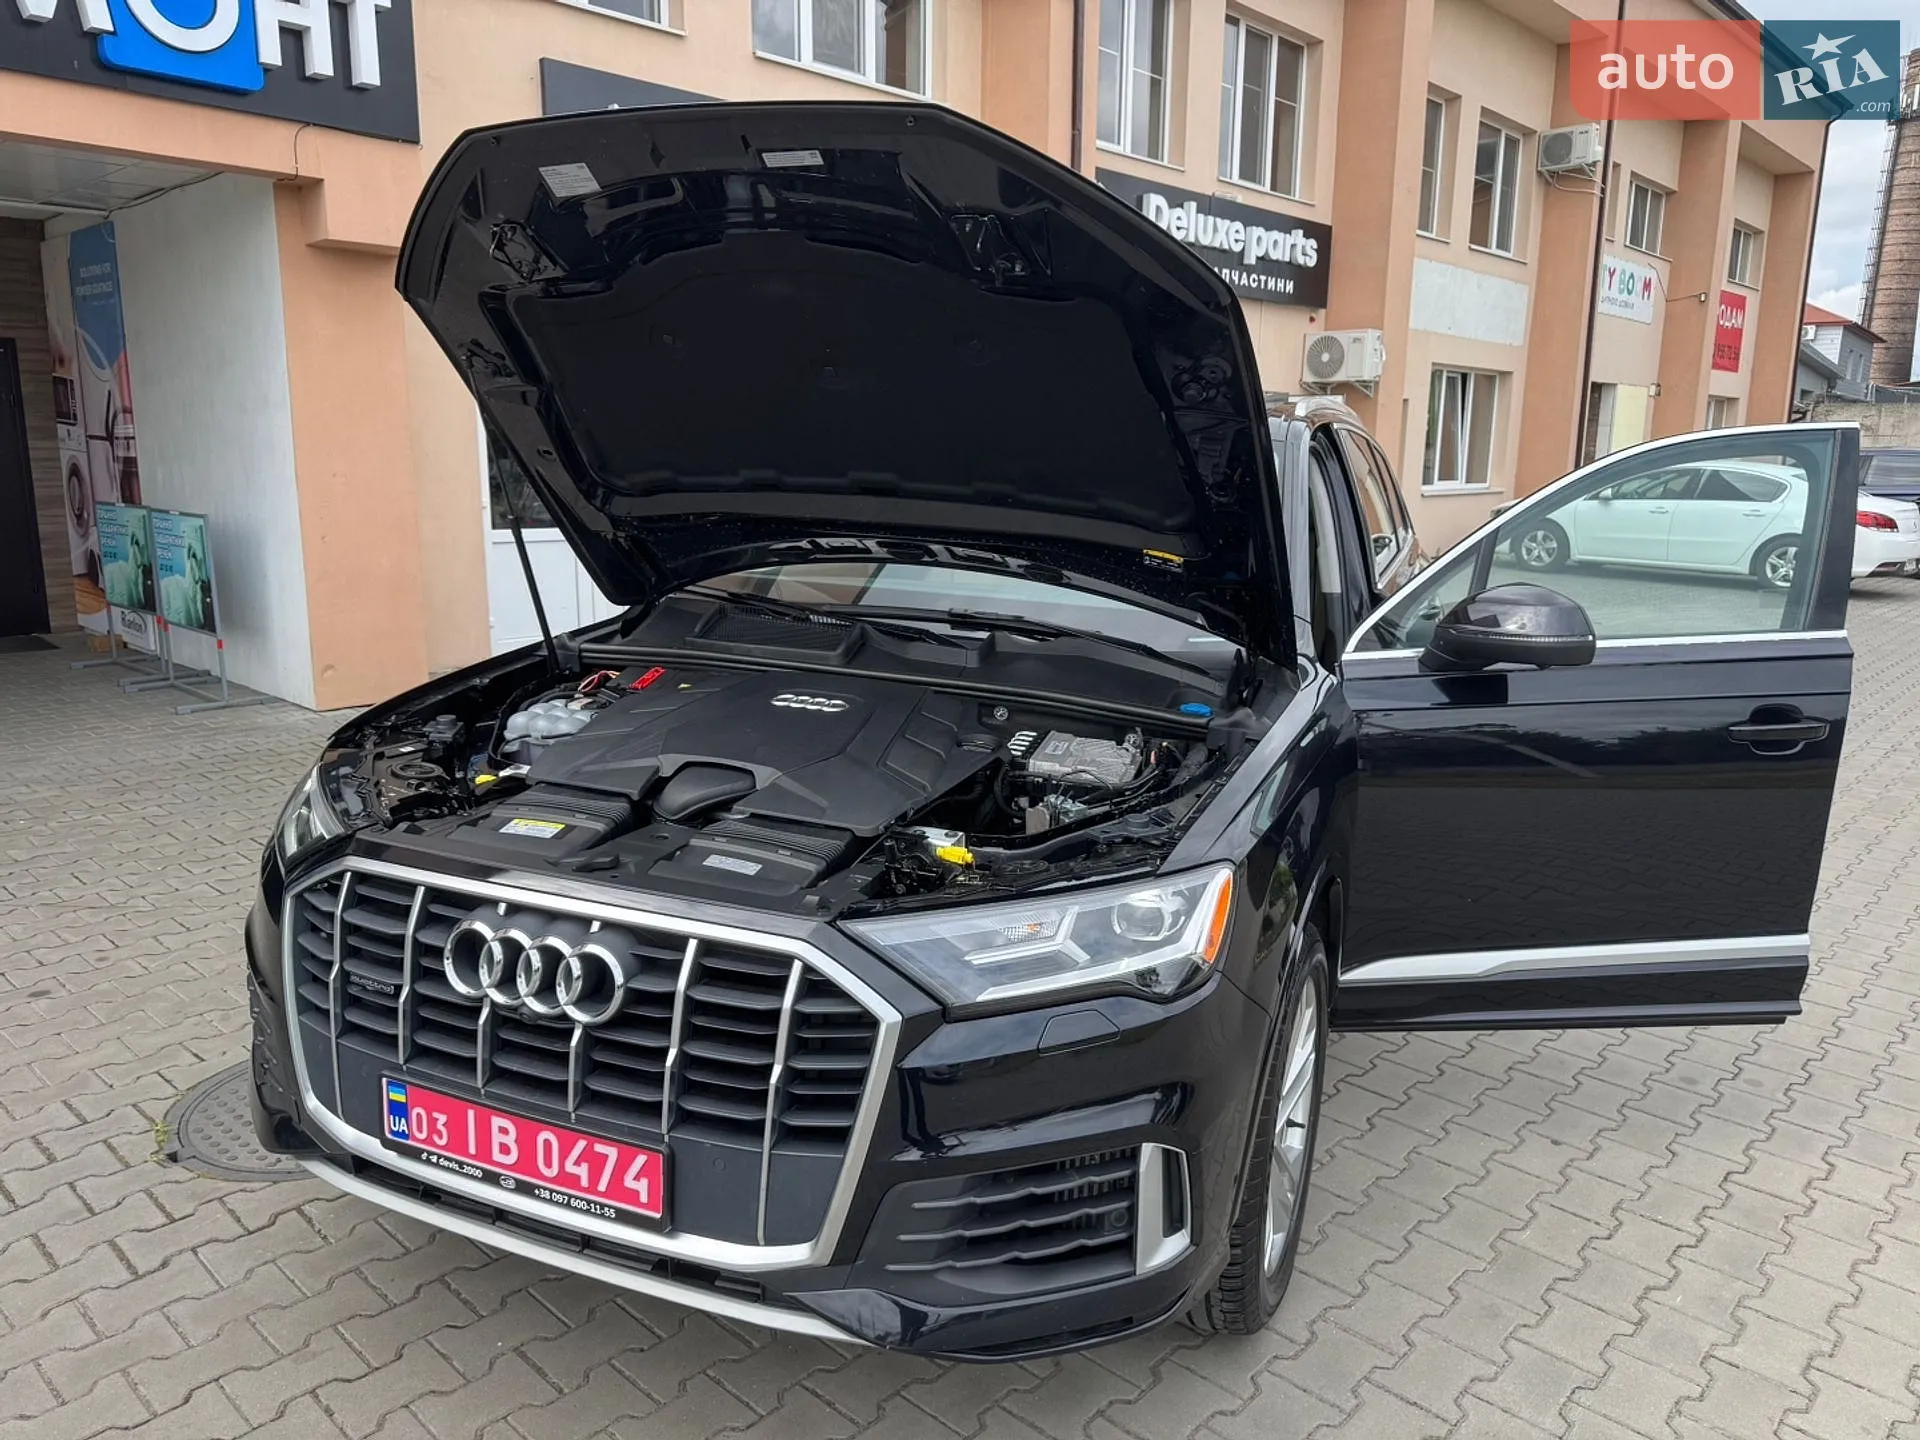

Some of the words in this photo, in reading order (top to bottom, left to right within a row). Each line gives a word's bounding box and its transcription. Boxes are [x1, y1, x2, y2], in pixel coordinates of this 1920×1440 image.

[1717, 303, 1745, 330] ОДАМ
[390, 1114, 409, 1135] UA
[411, 1106, 449, 1146] 03
[466, 1108, 519, 1166] IB
[536, 1130, 650, 1204] 0474
[551, 1192, 569, 1205] 097
[570, 1198, 617, 1219] 600-11-55
